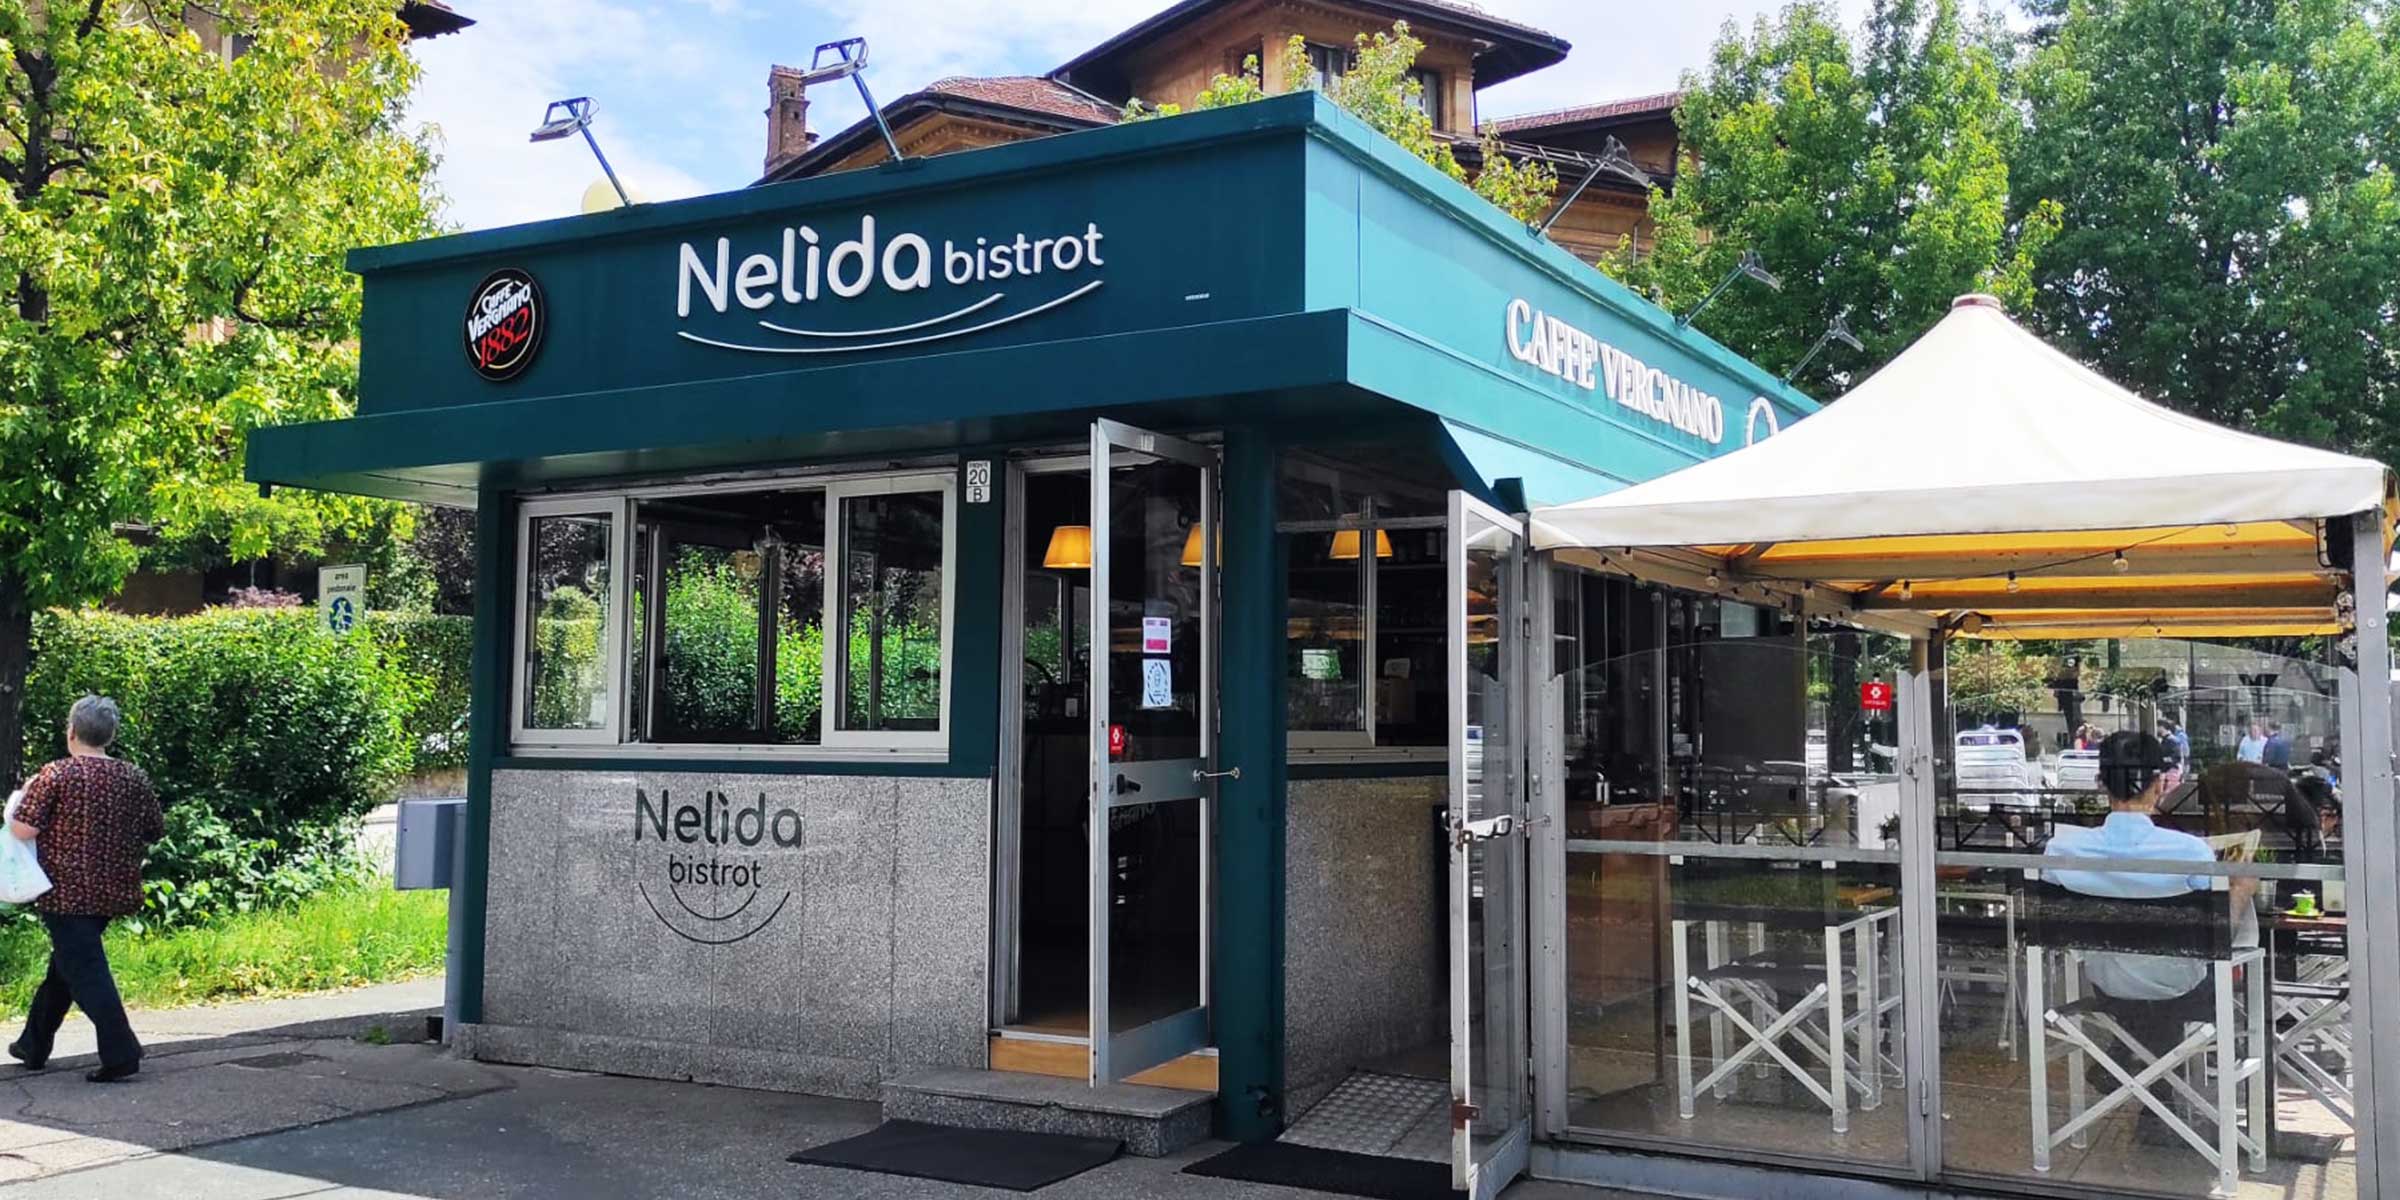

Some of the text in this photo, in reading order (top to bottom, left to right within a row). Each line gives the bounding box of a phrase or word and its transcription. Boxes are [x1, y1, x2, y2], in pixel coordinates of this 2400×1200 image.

[678, 215, 1104, 317] Nelìda bistrot
[481, 307, 529, 367] 1882
[1600, 342, 1723, 444] VERGNANO
[969, 468, 988, 485] 20
[973, 487, 983, 501] B
[635, 788, 802, 848] Nelìda
[669, 854, 762, 888] bistrot
